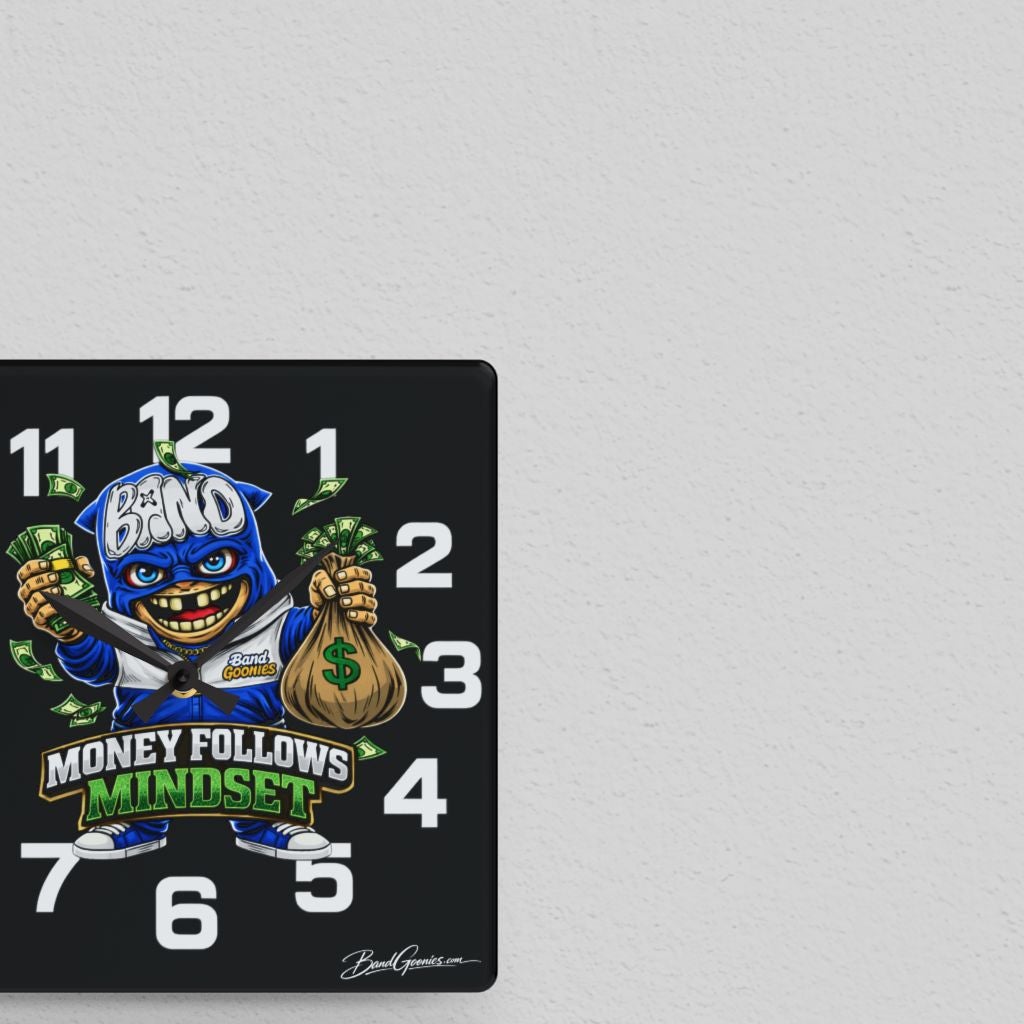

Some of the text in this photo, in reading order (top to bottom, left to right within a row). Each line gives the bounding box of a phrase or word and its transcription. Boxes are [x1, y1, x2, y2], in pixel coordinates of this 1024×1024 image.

[10, 428, 75, 497] 11
[138, 395, 231, 463] 12
[305, 428, 337, 479] 1
[104, 473, 246, 561] BAND
[395, 521, 453, 589] 2
[228, 649, 270, 668] Band
[322, 637, 362, 691] $
[421, 640, 483, 709] 3
[46, 727, 349, 788] MONEY FOLLOWS
[86, 767, 316, 822] MINDSET
[383, 758, 448, 828] 4
[20, 842, 80, 913] 7
[295, 842, 354, 913] 5
[155, 875, 218, 950] 6
